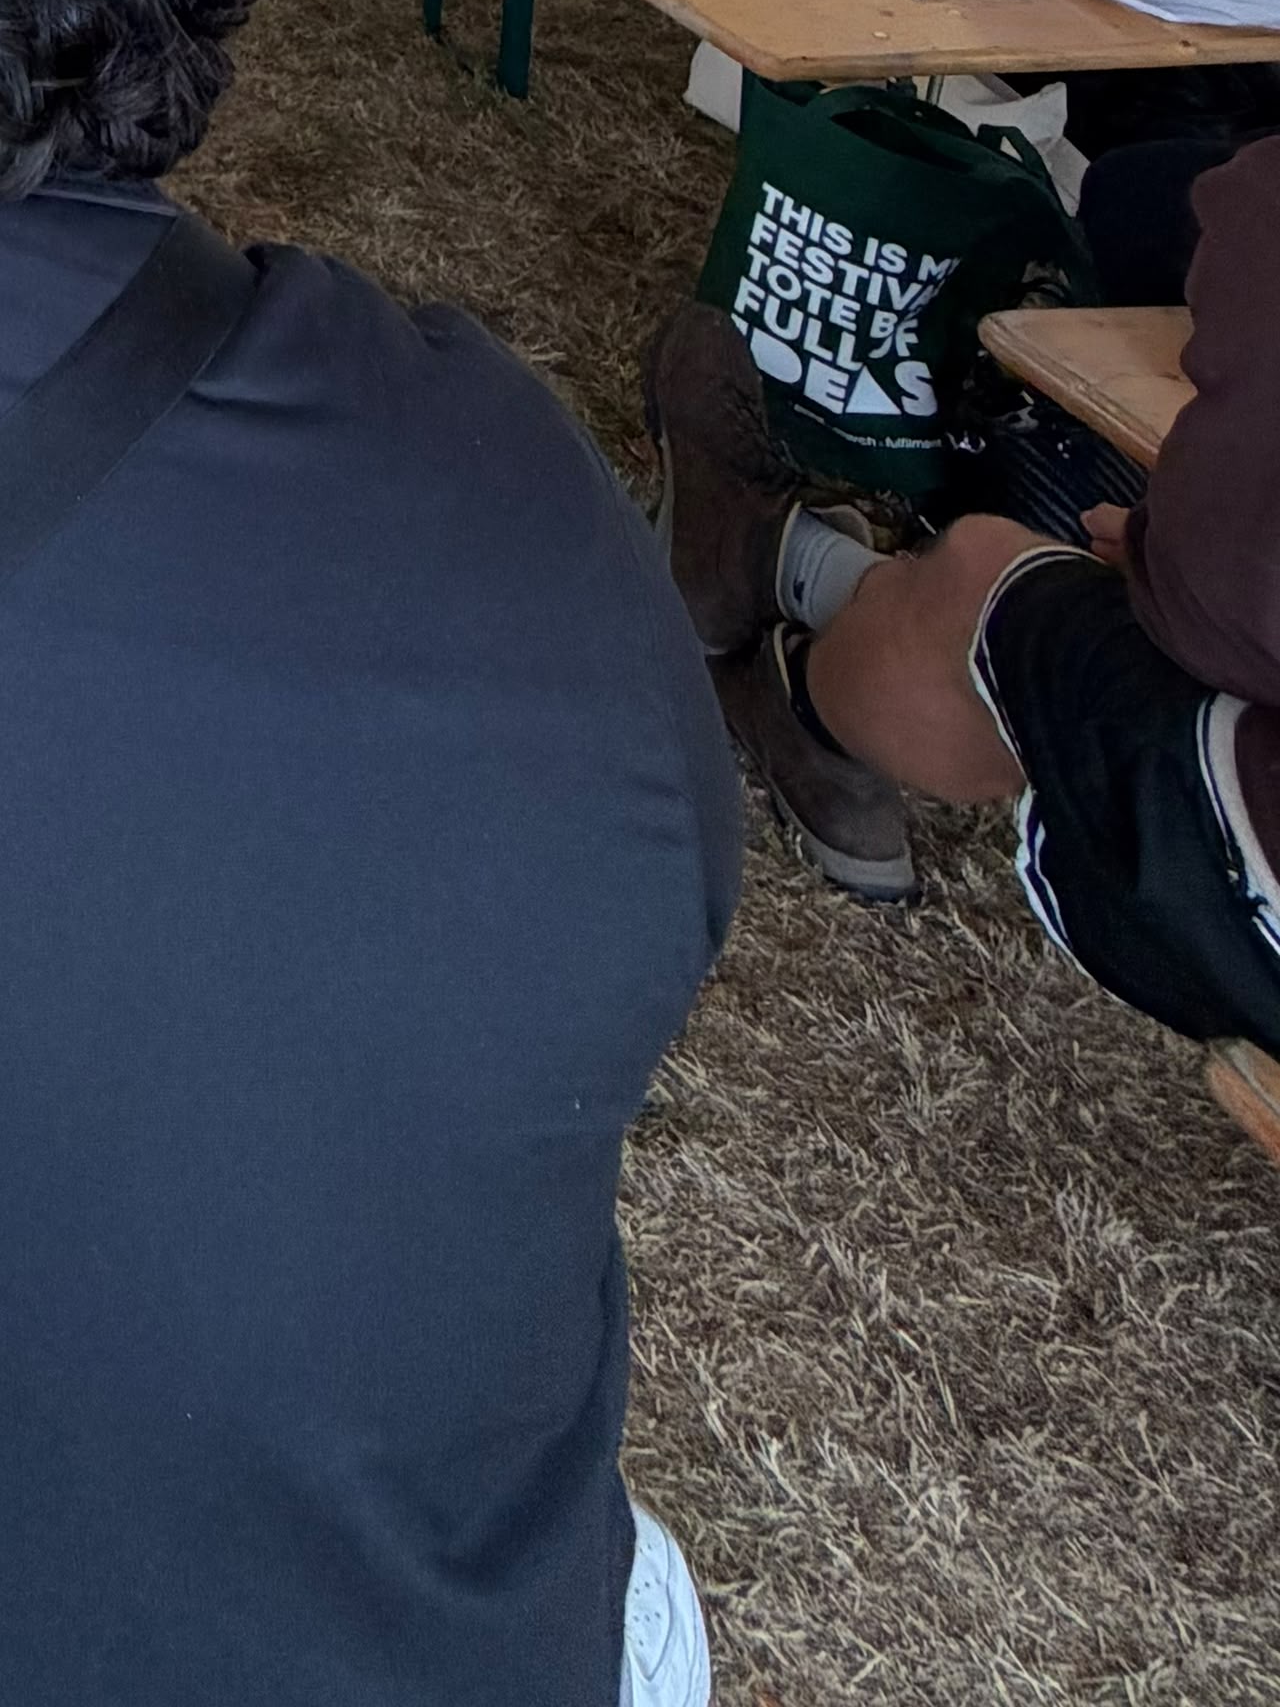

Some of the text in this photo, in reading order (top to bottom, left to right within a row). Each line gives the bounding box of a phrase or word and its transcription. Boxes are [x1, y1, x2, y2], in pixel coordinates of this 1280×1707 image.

[762, 181, 854, 256] THIS
[863, 237, 908, 274] IS
[733, 276, 865, 371] FULL
[747, 245, 862, 332] TOTE
